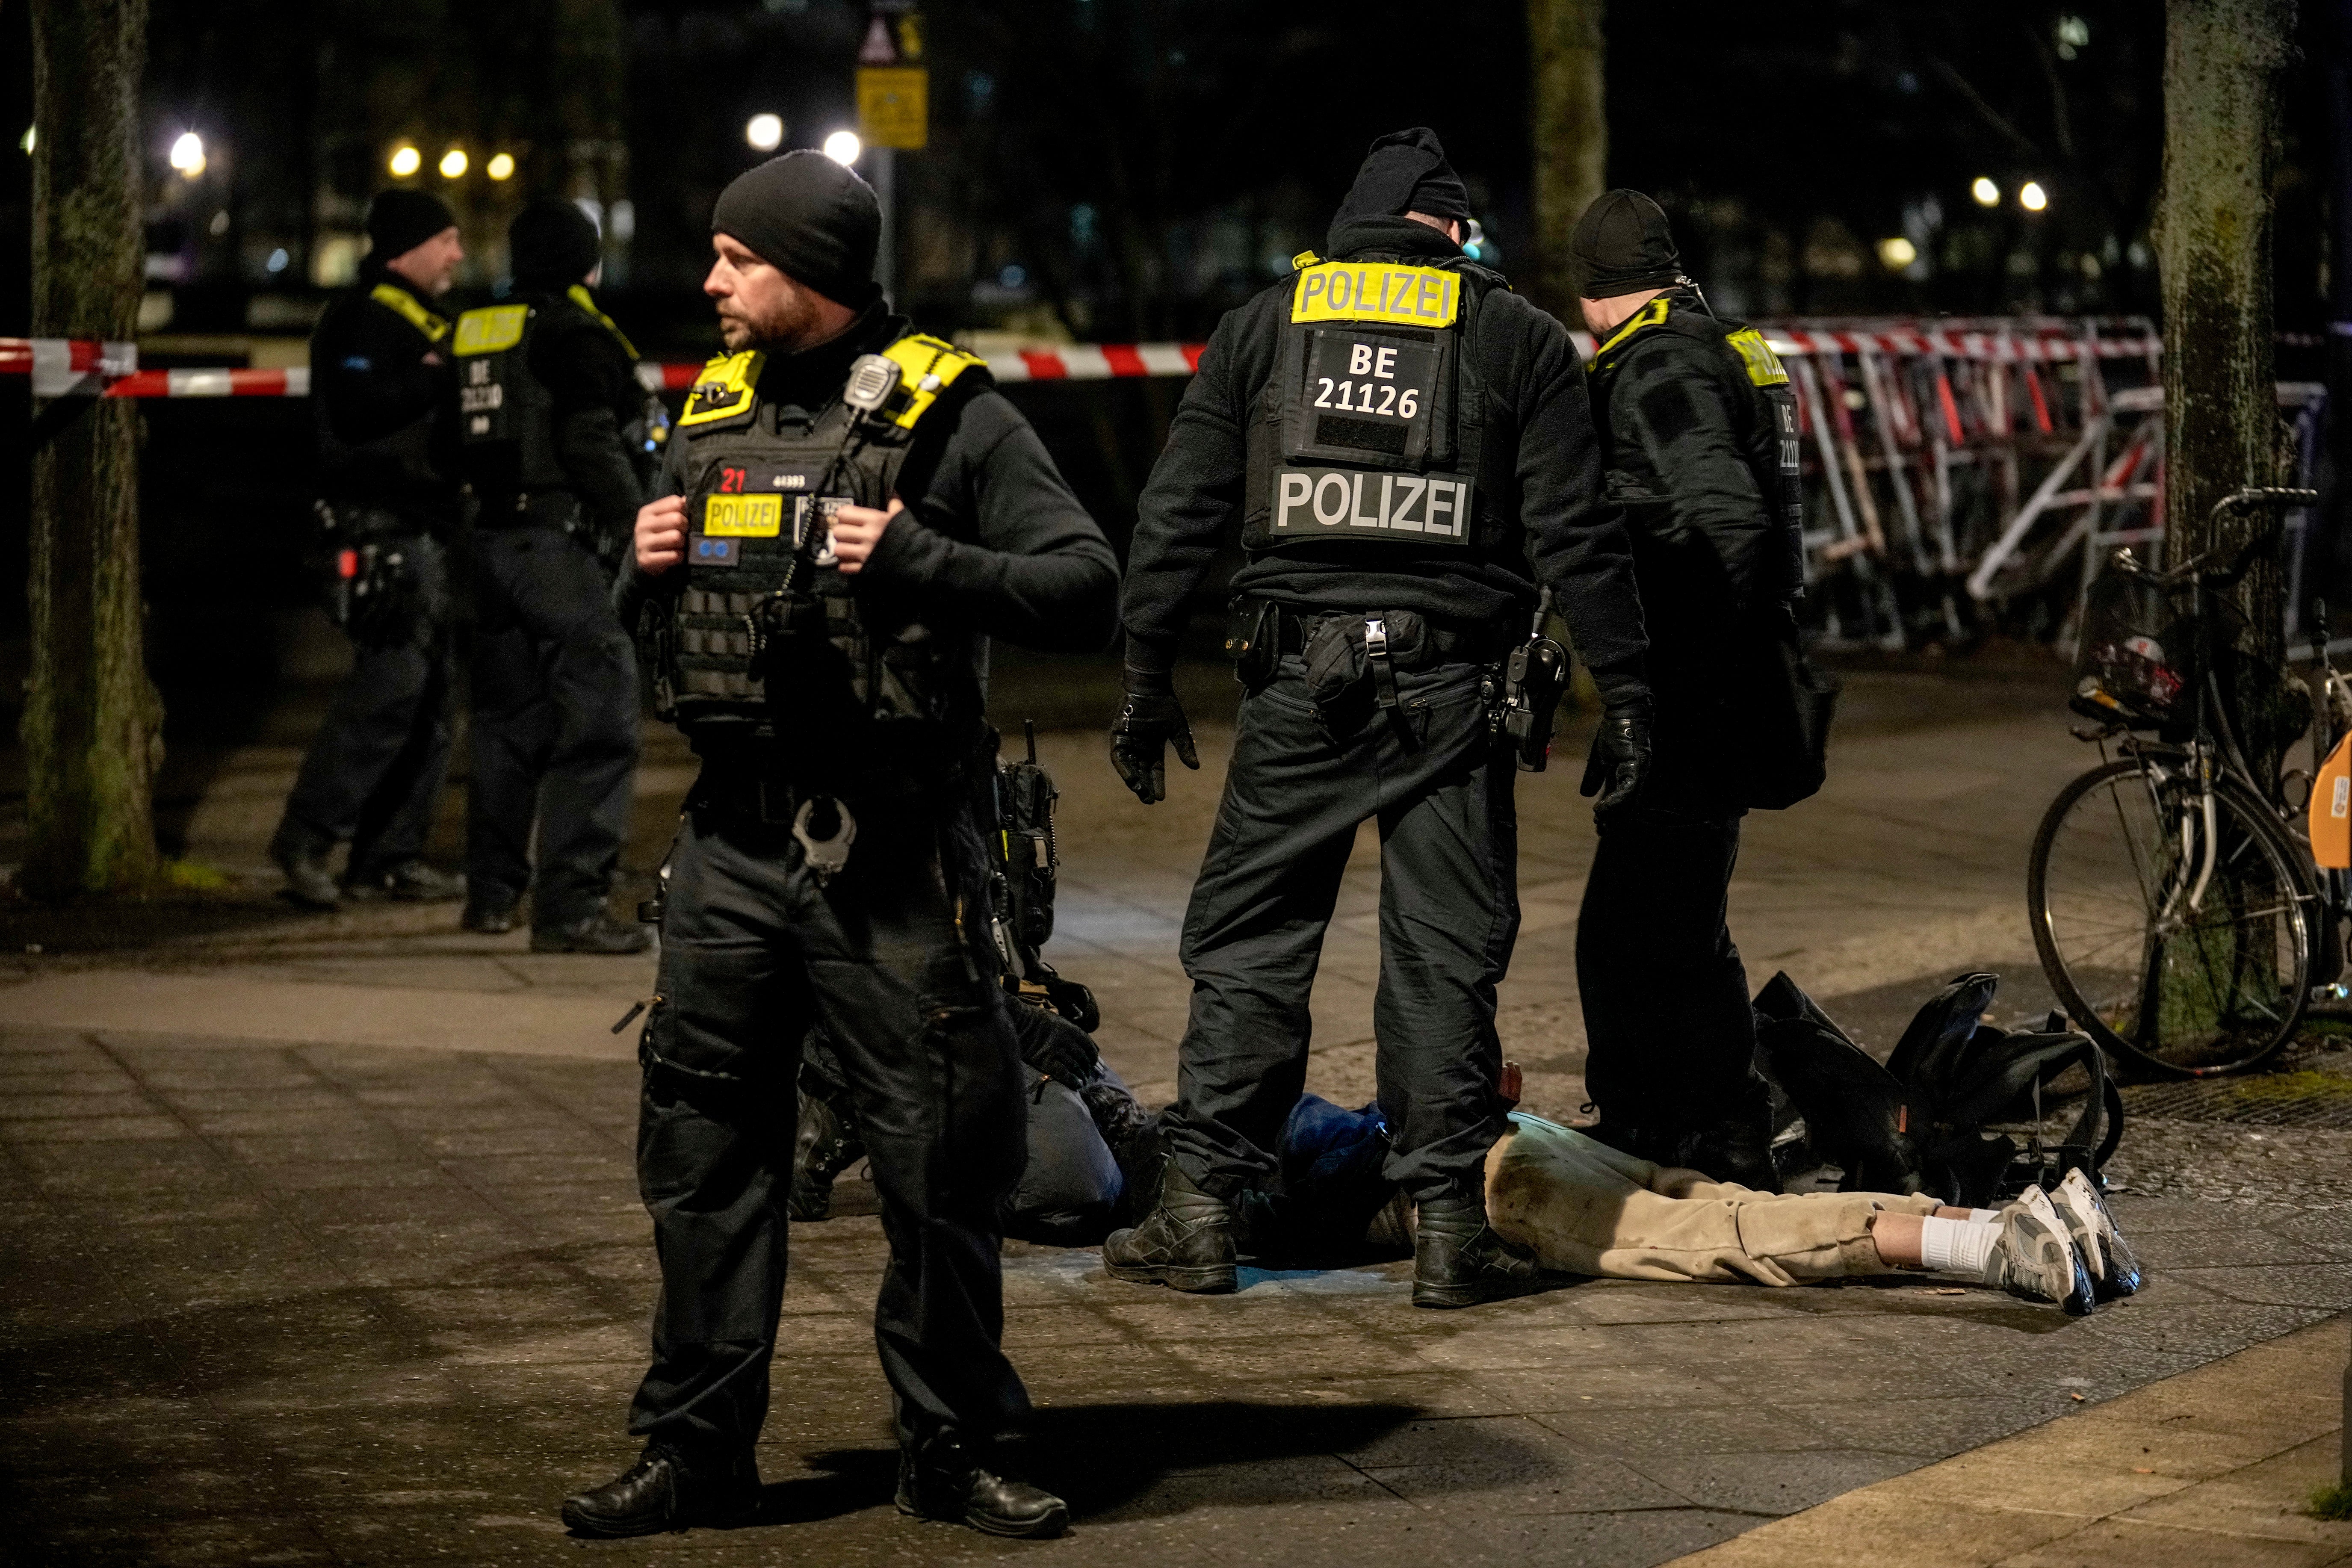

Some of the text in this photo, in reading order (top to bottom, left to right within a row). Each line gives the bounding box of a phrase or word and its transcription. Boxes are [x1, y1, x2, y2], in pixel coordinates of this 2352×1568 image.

[1301, 271, 1451, 319] POLIZEI
[1349, 344, 1398, 379] BE
[1314, 378, 1419, 419] 21126
[1781, 405, 1794, 432] BE
[721, 468, 745, 492] 21
[710, 502, 777, 527] POLIZEI
[1278, 473, 1466, 536] POLIZEI
